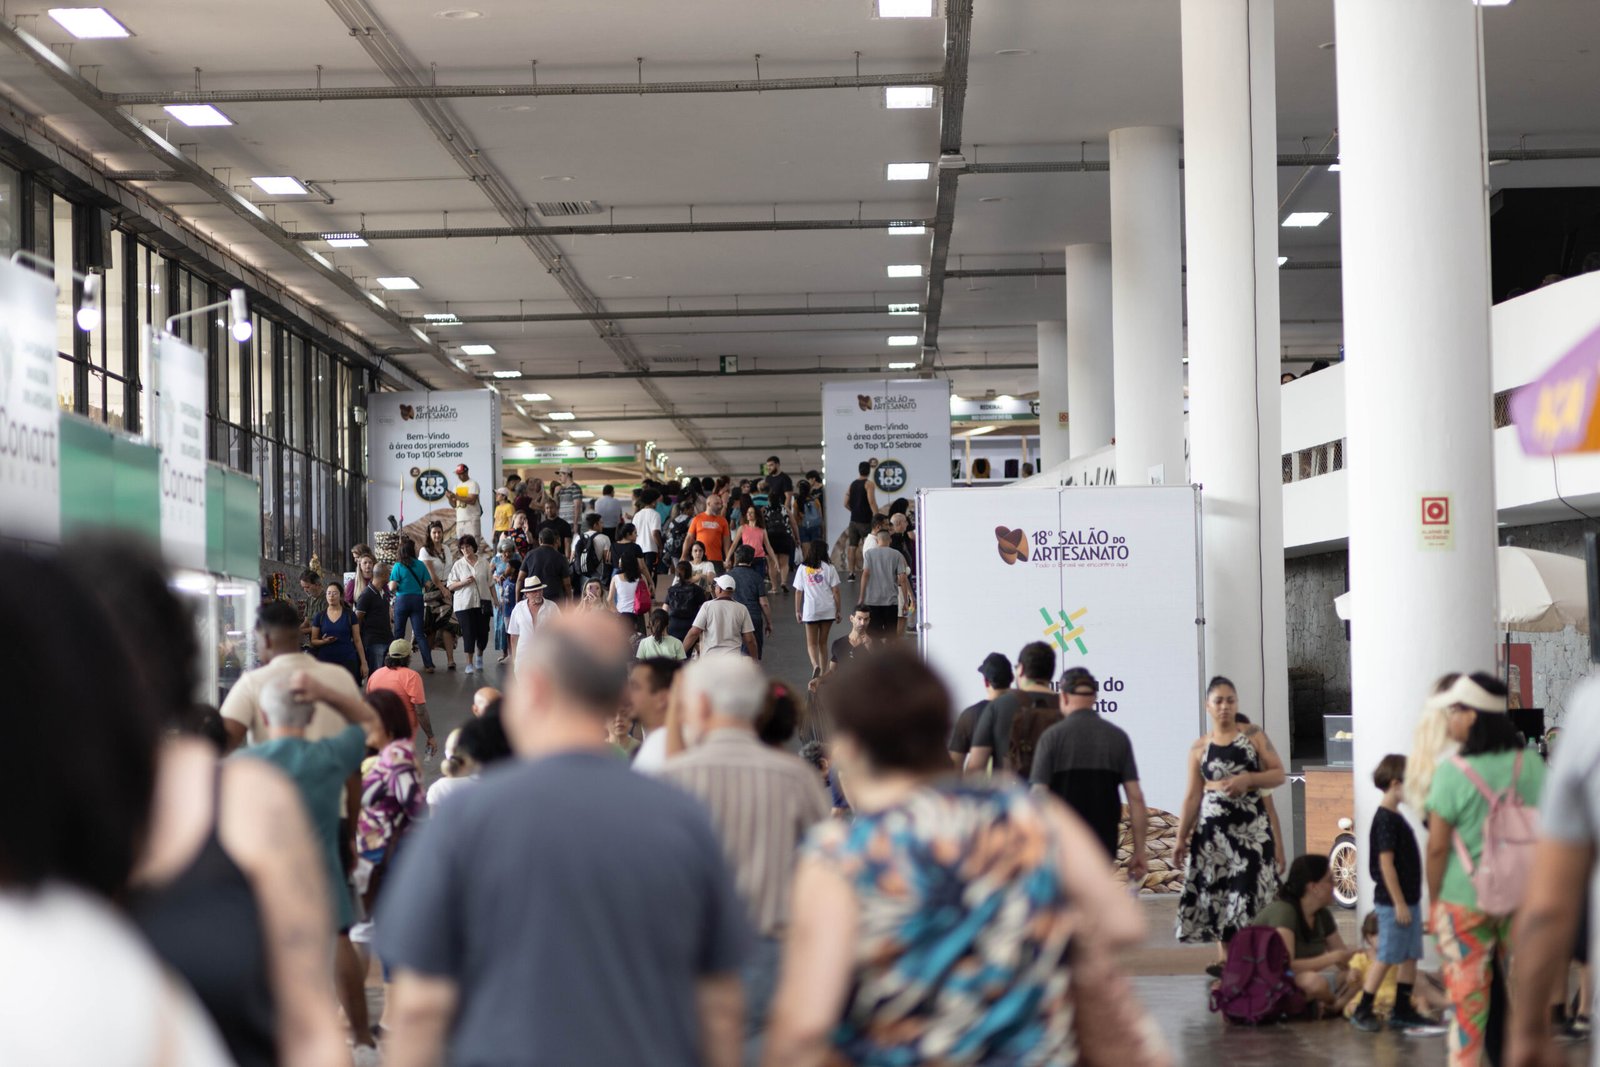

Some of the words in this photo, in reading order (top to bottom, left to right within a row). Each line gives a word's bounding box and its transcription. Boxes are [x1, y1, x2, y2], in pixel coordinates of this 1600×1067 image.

[885, 394, 908, 403] SALÃO
[427, 404, 449, 413] SALÃO
[873, 402, 917, 410] ARTESANATO
[415, 412, 458, 420] ARTESANATO
[864, 423, 909, 431] Bem-Vindo
[406, 432, 450, 440] Bem-Vindo
[853, 432, 871, 440] área
[872, 432, 886, 440] dos
[887, 432, 928, 442] premiados
[396, 442, 413, 450] área
[414, 442, 428, 450] dos
[428, 441, 470, 451] premiados
[853, 442, 863, 450] do
[865, 442, 878, 451] Top
[895, 441, 922, 449] Sebrae
[407, 452, 420, 460] Top
[878, 468, 903, 477] TOP
[420, 477, 444, 486] TOP
[878, 477, 904, 486] 100
[420, 486, 445, 495] 100
[1058, 527, 1109, 545] SALÃO
[1112, 536, 1126, 544] DO
[1031, 545, 1129, 561] ARTESANATO
[1103, 677, 1124, 692] do
